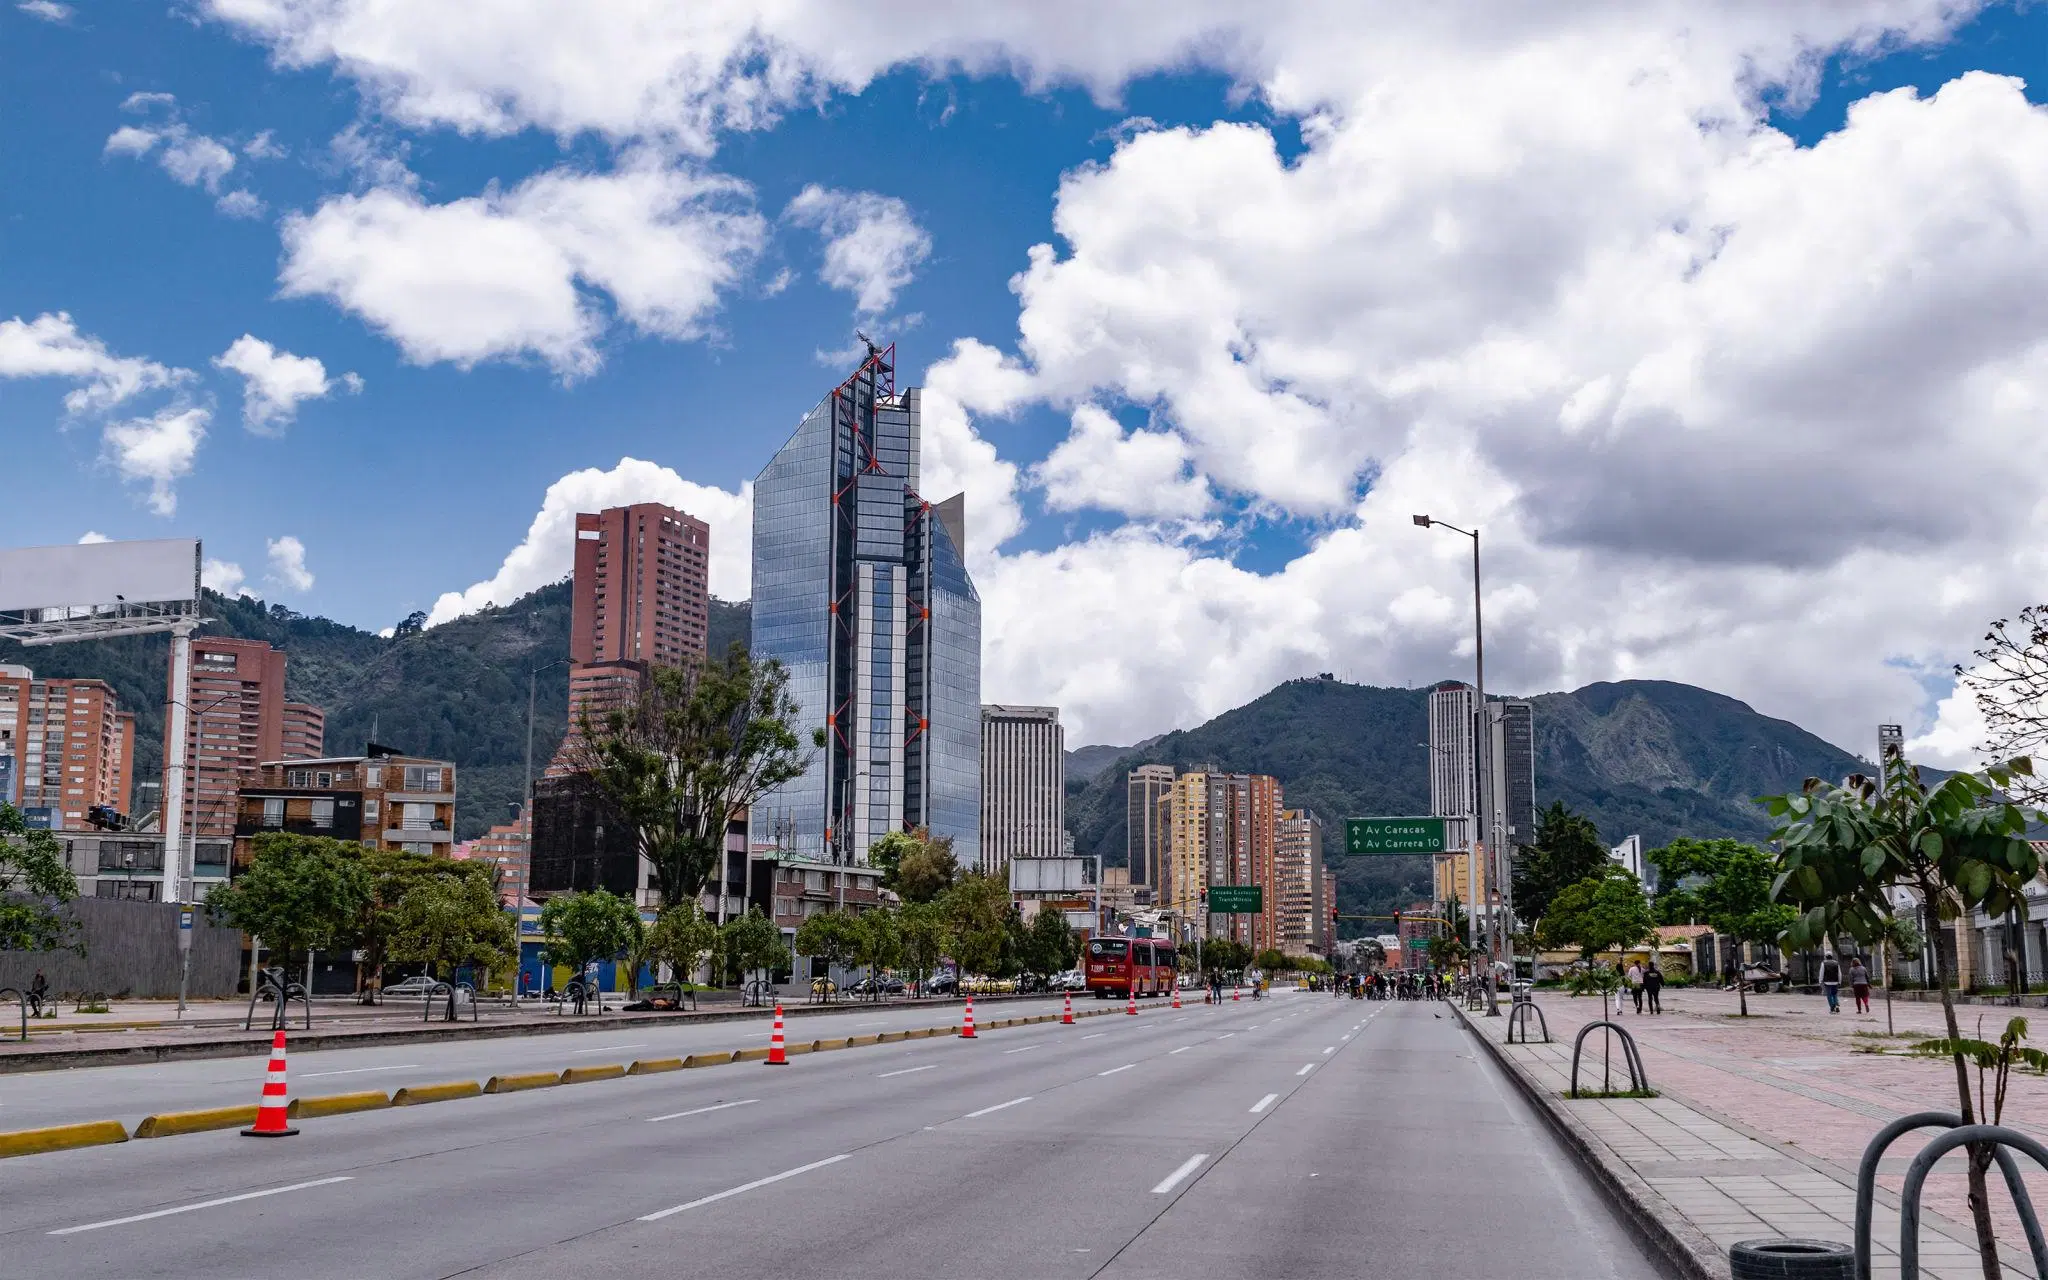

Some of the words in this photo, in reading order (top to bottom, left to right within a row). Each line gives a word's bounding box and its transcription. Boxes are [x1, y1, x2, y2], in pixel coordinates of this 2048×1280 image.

[1365, 825, 1380, 834] Av
[1384, 825, 1426, 834] Caracas
[1366, 839, 1380, 848] Av
[1385, 839, 1423, 848] Carrera
[1427, 838, 1440, 847] 10
